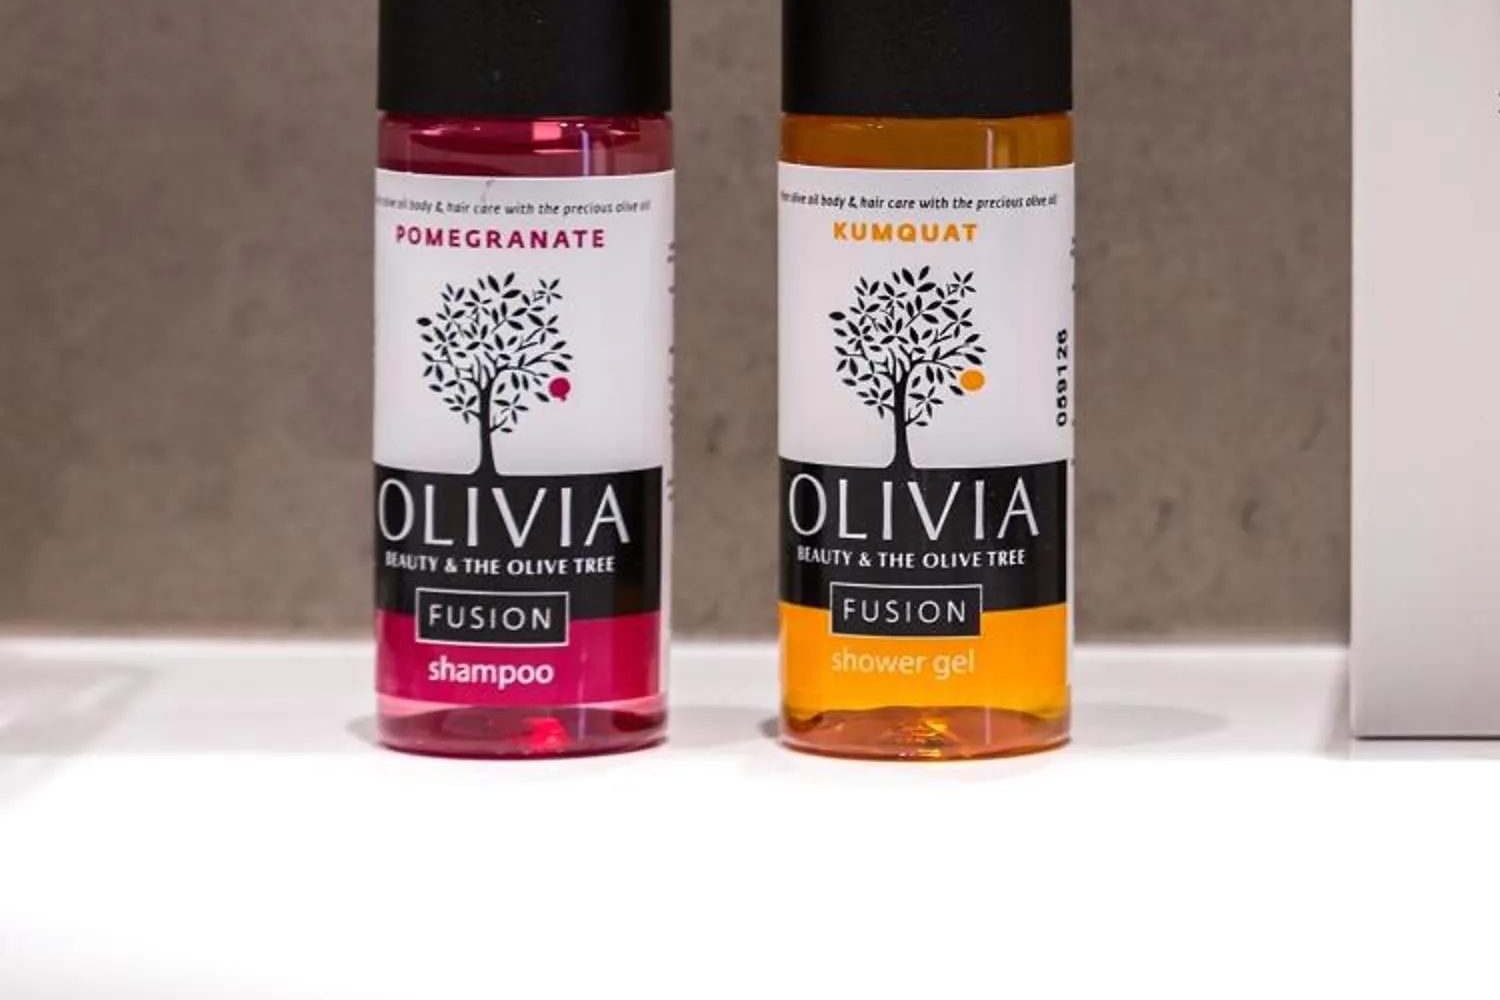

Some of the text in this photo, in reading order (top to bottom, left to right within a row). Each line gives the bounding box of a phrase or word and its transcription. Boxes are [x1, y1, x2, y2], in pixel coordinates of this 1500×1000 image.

[435, 201, 444, 213] &
[446, 201, 470, 213] hair
[473, 203, 501, 215] care
[505, 202, 534, 215] with
[538, 202, 559, 215] the
[563, 202, 612, 216] precious
[821, 194, 846, 210] body
[848, 196, 858, 209] &
[861, 196, 885, 209] hair
[888, 198, 915, 209] care
[919, 197, 948, 209] with
[952, 196, 973, 209] the
[976, 195, 1023, 212] precious
[1026, 194, 1046, 207] olive
[396, 225, 605, 249] POMEGRANATE
[833, 221, 978, 242] KUMQUAT
[378, 478, 631, 548] OLIVIA
[789, 473, 1039, 541] OLIVIA
[385, 551, 616, 576] BEAUTY & THE OLIVE TREE
[797, 545, 1025, 568] BEAUTY & THE OLIVE TREE
[428, 603, 552, 631] FUSION
[842, 598, 966, 623] FUSION
[428, 655, 554, 690] shampoo
[832, 647, 975, 680] shower gel
